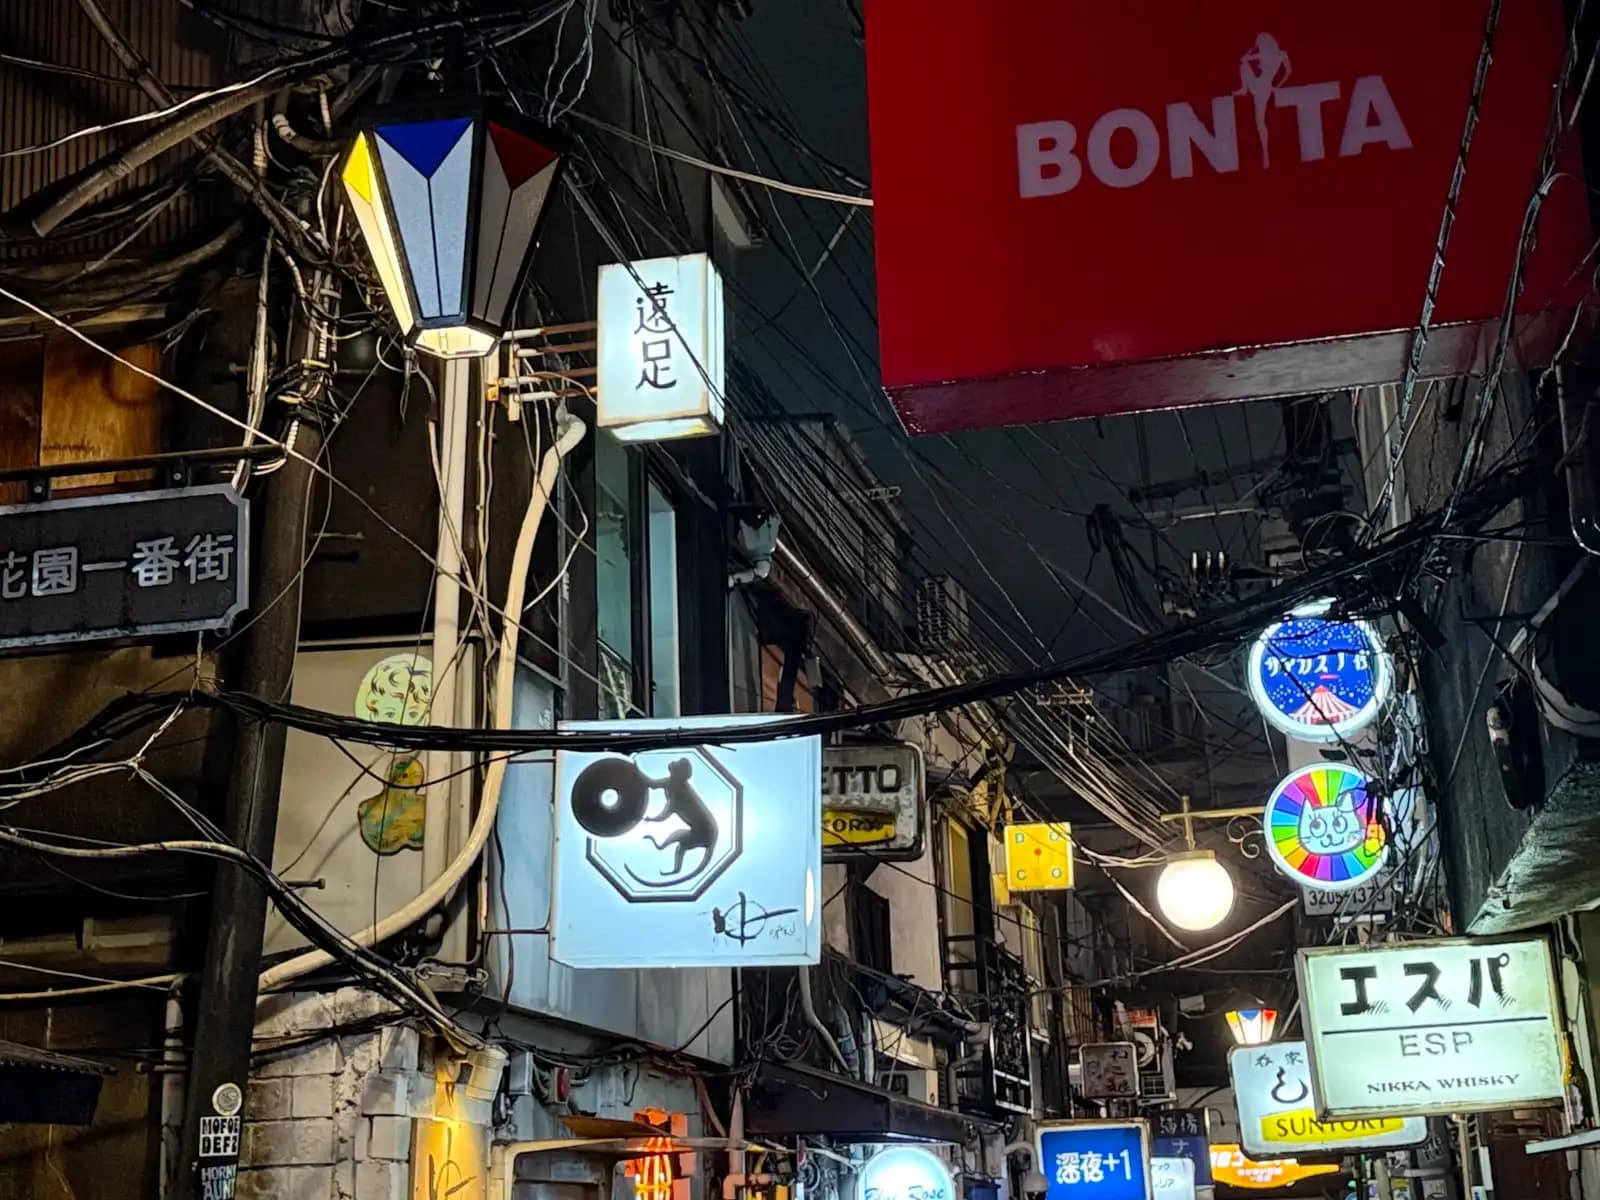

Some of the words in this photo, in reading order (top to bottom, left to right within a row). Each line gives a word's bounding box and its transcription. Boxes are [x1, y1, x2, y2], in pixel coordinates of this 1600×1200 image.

[1016, 32, 1413, 198] BONITA
[634, 282, 677, 391] 遠足
[0, 534, 234, 599] 花園一番街
[1340, 952, 1510, 1016] エスパ
[1399, 1031, 1473, 1057] ESP
[1367, 1080, 1431, 1094] NIKKA
[1437, 1074, 1520, 1090] WHISKY
[1056, 1149, 1132, 1185] 深夜+1
